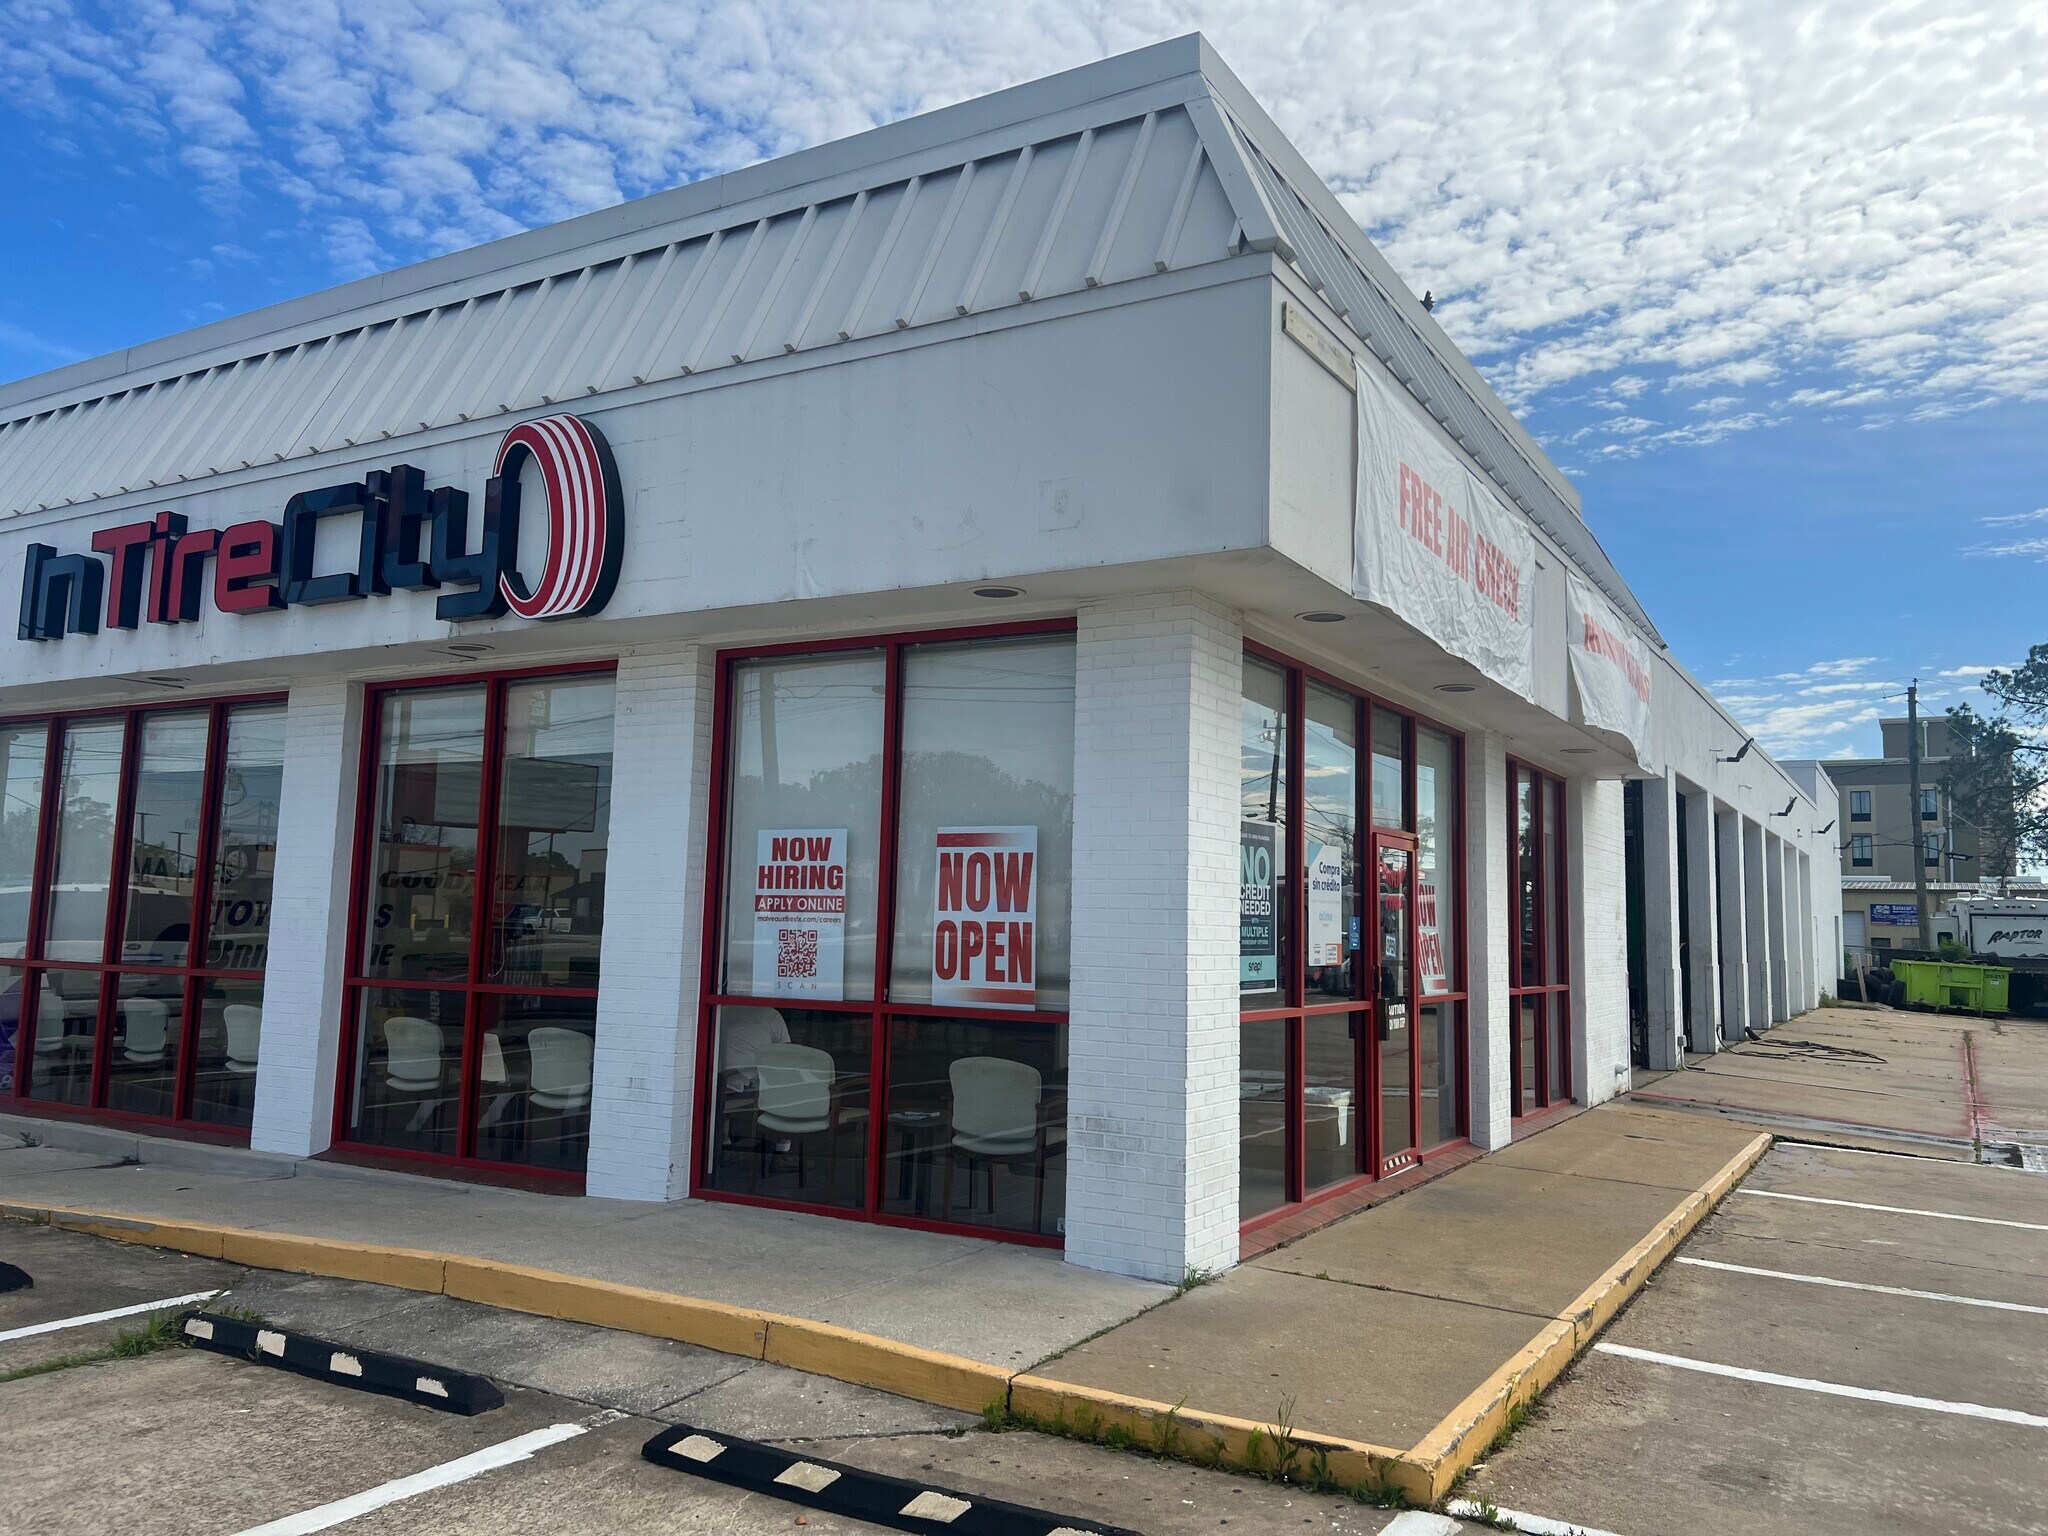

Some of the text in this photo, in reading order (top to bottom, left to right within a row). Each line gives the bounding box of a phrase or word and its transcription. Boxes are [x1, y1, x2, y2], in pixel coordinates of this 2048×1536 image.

[1400, 461, 1519, 622] FREE AIR CHECK
[771, 837, 832, 862] NOW
[1240, 845, 1270, 887] NO
[1319, 861, 1340, 878] Compra
[758, 865, 844, 890] HIRING
[938, 851, 1034, 913] NOW
[1312, 877, 1340, 892] sin crédito
[1240, 883, 1271, 900] CREDIT
[757, 898, 843, 911] APPLY ONLINE
[1239, 900, 1271, 915] NEEDED
[1418, 884, 1436, 927] OW
[1241, 927, 1269, 937] MULTIPLE
[1987, 929, 2043, 945] RAPTOR
[935, 920, 1033, 983] OPEN
[777, 982, 817, 990] SCAN
